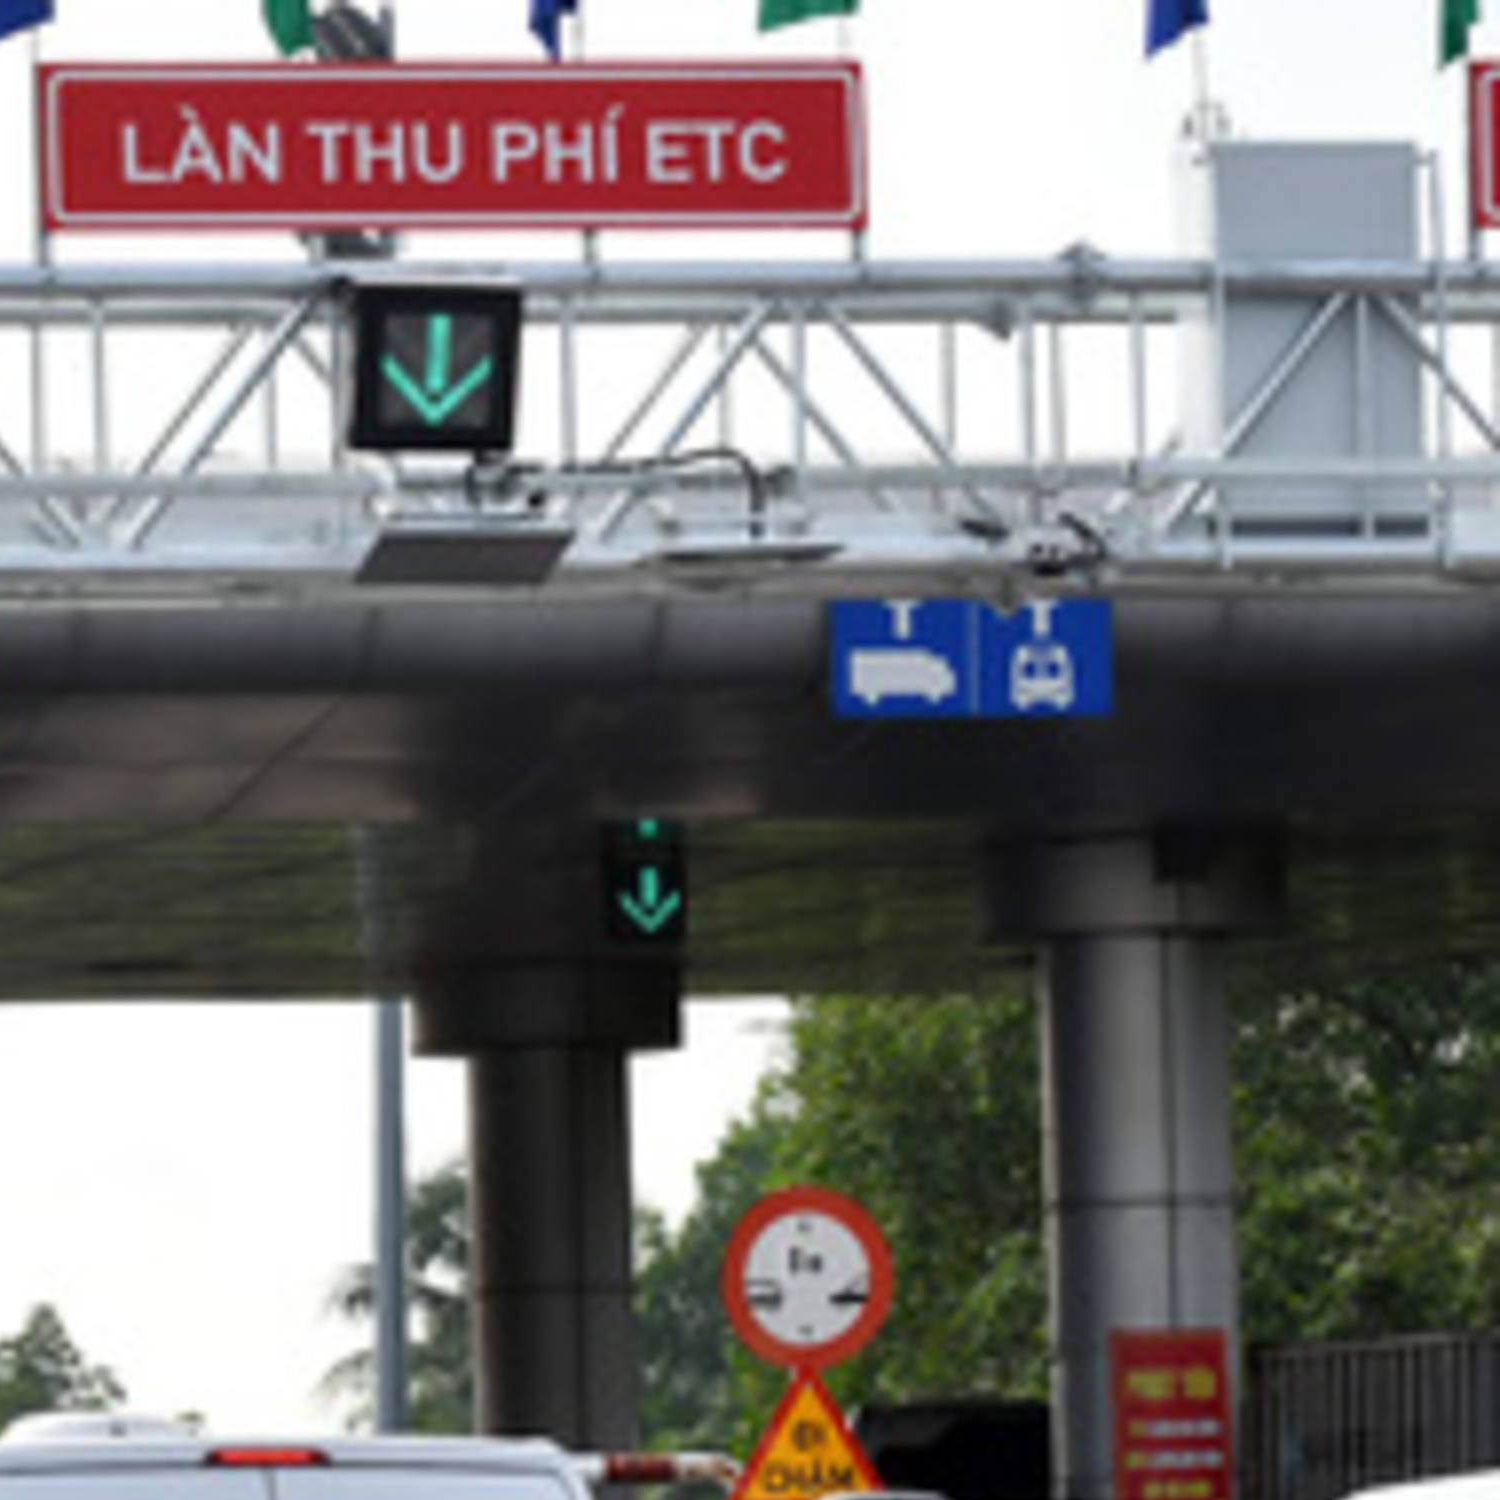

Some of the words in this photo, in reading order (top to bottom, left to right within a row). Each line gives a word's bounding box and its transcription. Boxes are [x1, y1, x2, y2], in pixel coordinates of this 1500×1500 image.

[123, 106, 280, 184] LÀN
[306, 121, 463, 181] THU
[494, 104, 625, 180] PHÍ
[647, 121, 786, 180] ETC
